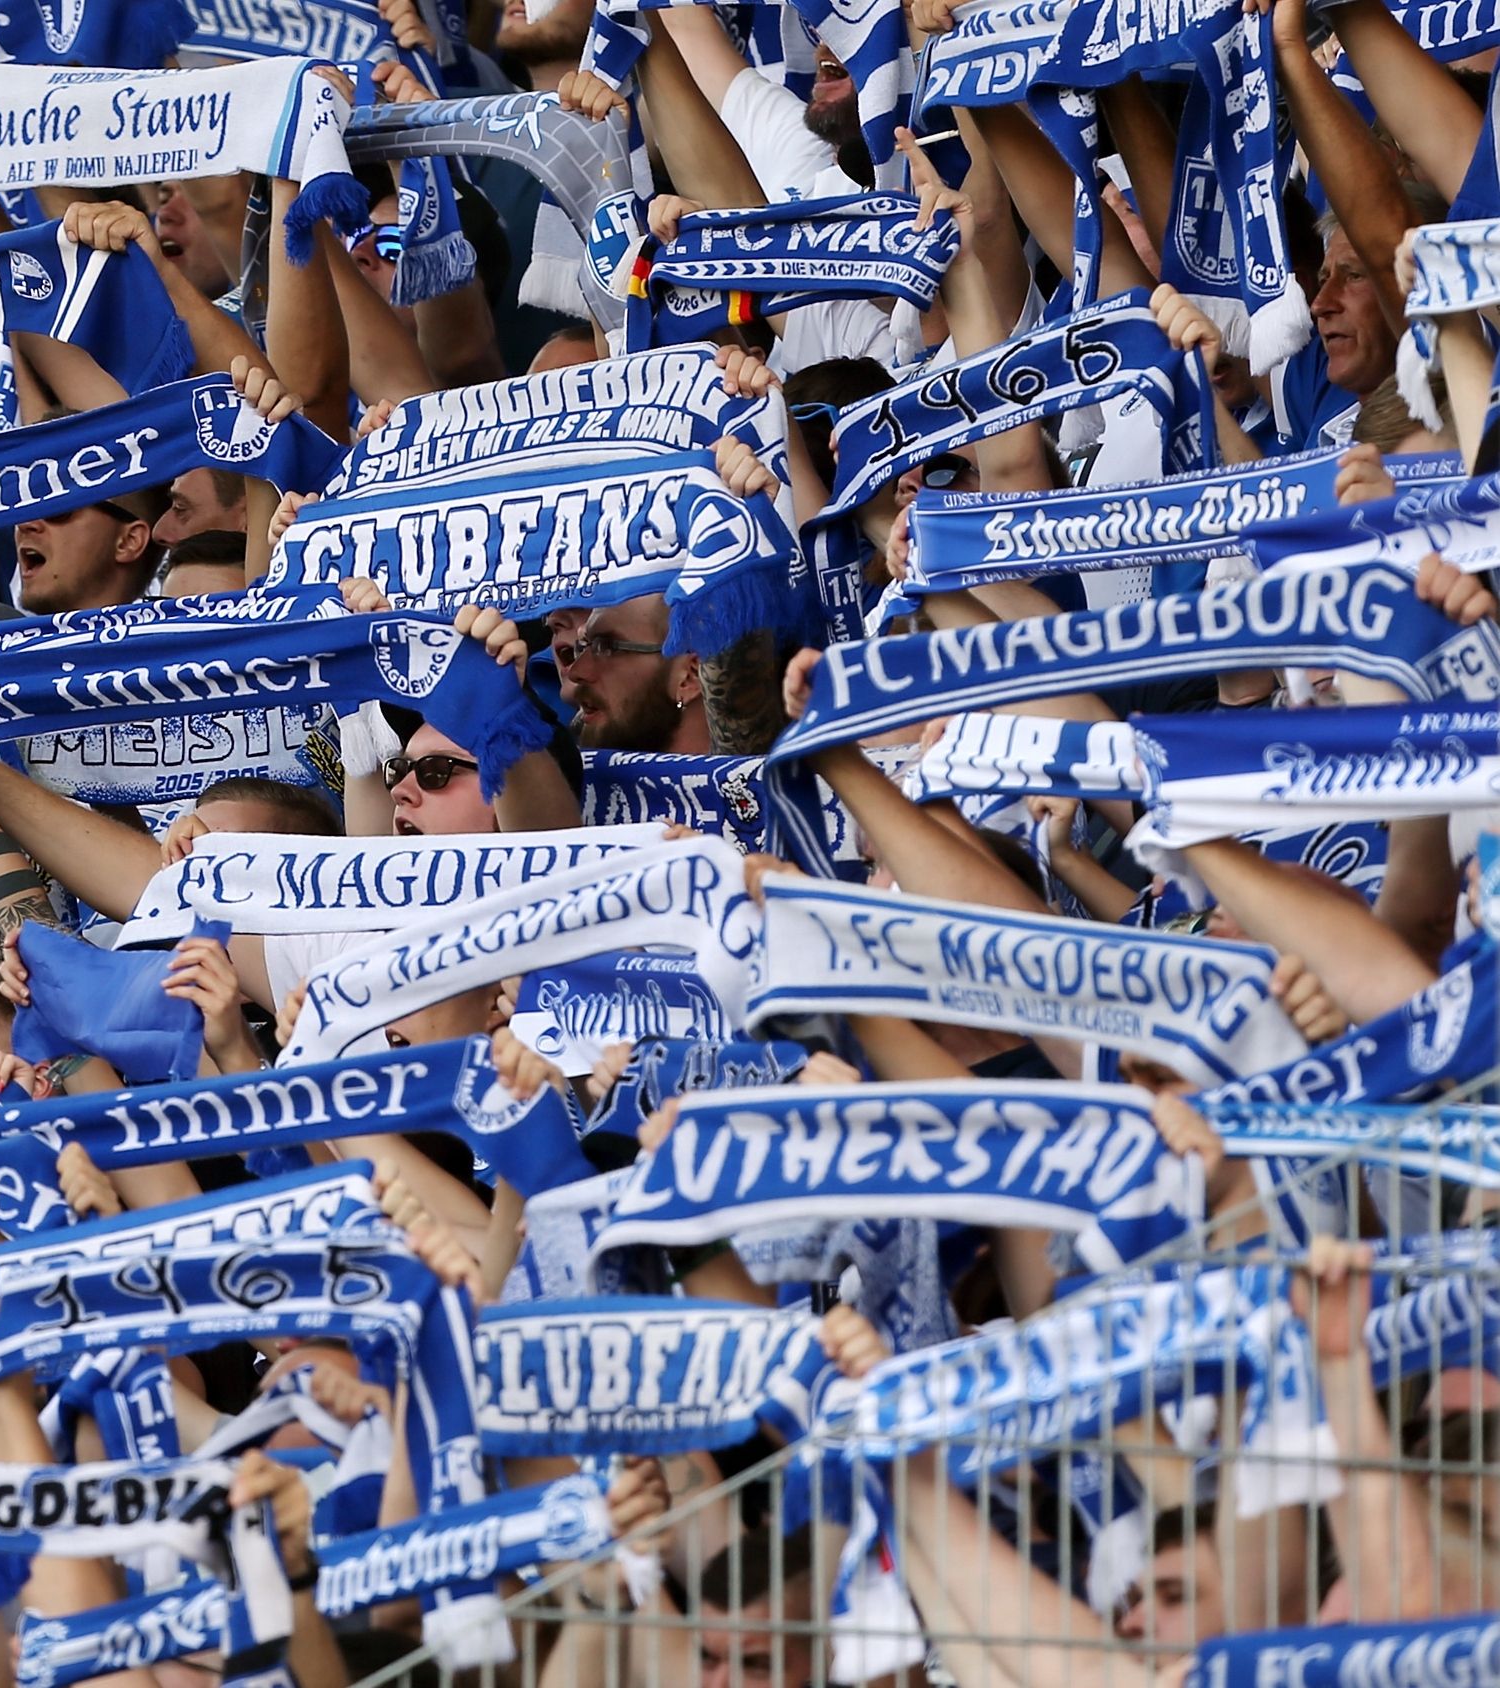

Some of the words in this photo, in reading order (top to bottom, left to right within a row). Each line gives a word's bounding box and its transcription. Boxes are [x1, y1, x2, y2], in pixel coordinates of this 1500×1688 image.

[105, 86, 232, 160] Stawy
[65, 156, 106, 178] DOMU
[113, 149, 199, 177] NAJLEPIEJ!
[808, 261, 871, 277] MACHT
[869, 317, 1123, 465] 1965
[358, 438, 464, 486] SPIELEN
[469, 421, 520, 457] MIT
[525, 410, 580, 448] ALS
[908, 446, 933, 464] WIR
[948, 431, 970, 448] DIE
[300, 474, 689, 597] CLUBFANS
[824, 635, 915, 708] FC
[929, 563, 1411, 684] MAGDEBURG
[52, 651, 338, 712] immer
[27, 702, 322, 768] MEIST
[176, 851, 257, 910] FC
[268, 843, 643, 910] MAGDEB
[307, 958, 372, 1035] FC
[386, 853, 766, 992] MAGDEBURG
[809, 911, 925, 976] 1.FC
[937, 922, 1274, 1043] MAGDEBURG
[105, 1060, 430, 1153] immer
[29, 1242, 393, 1332] 1965
[1336, 1621, 1500, 1688] MAGD
